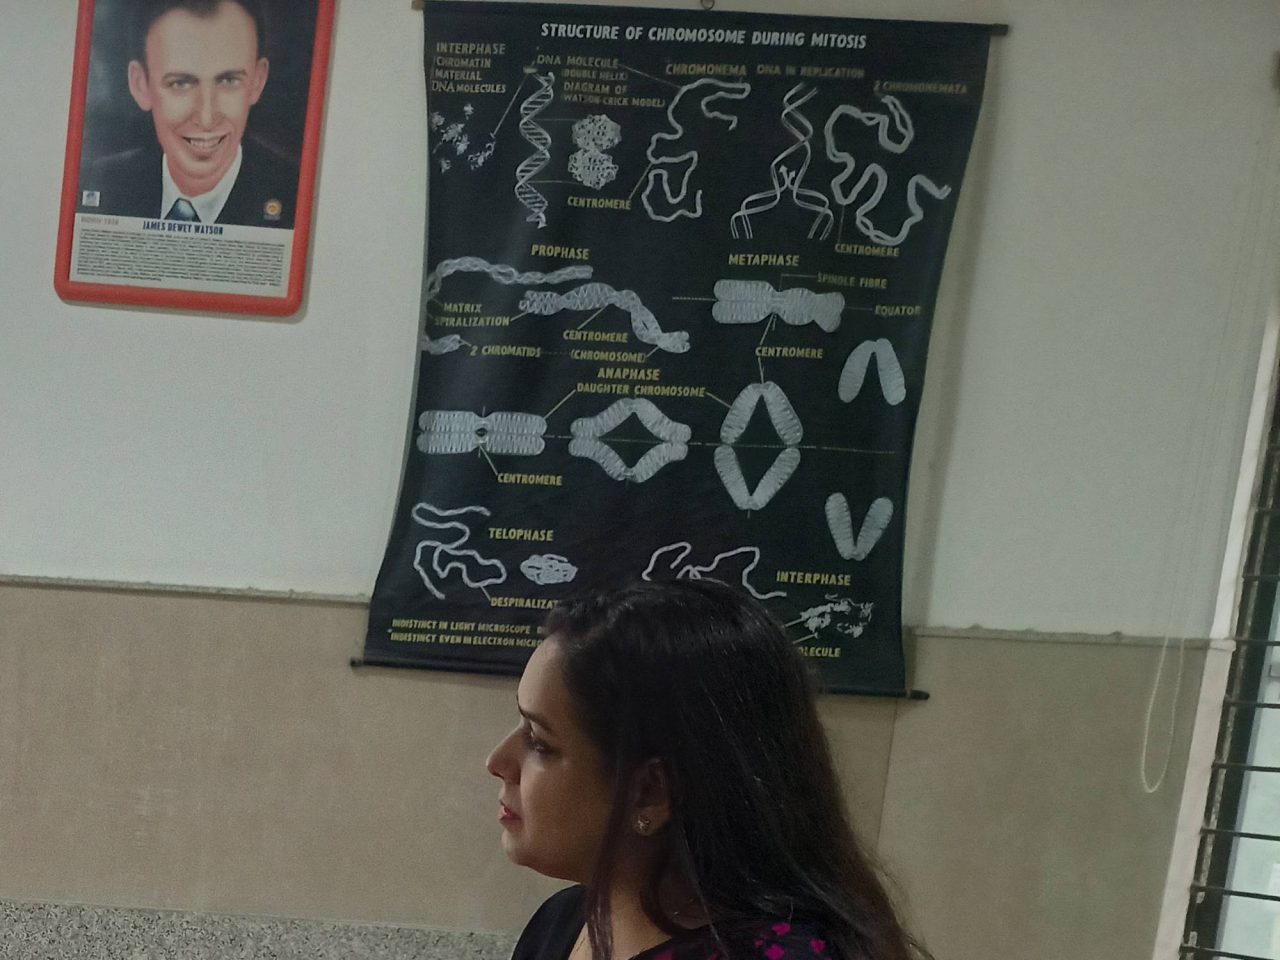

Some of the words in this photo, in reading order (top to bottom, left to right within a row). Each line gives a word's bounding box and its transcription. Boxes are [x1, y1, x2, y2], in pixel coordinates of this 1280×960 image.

[541, 23, 619, 40] STRUCTURE
[625, 26, 643, 40] OF
[648, 27, 746, 44] CHROMOSOME
[752, 31, 805, 47] DURING
[811, 33, 867, 49] MITOSIS
[436, 42, 506, 55] INTERPHASE
[537, 54, 561, 65] DNA
[566, 55, 619, 69] MOLECULE
[434, 69, 483, 81] MATERIAL
[665, 64, 746, 77] CHROMONEMA
[756, 65, 781, 75] DNA
[800, 66, 865, 79] REPLICATION
[431, 81, 455, 93] DNA
[456, 83, 507, 94] MOLECULES
[563, 82, 612, 94] DIAGRAM
[614, 84, 628, 94] OF
[567, 196, 632, 210] CENTROMERE
[143, 220, 166, 232] JAMES
[167, 222, 192, 233] DEWEY
[194, 224, 224, 236] WATSON
[531, 244, 590, 260] PROPHASE
[834, 243, 900, 257] CENTROMERE
[728, 254, 800, 267] METAPHASE
[817, 272, 855, 287] SPINDLE
[859, 277, 888, 289] FIBRE
[443, 302, 482, 313] MATRIX
[874, 305, 921, 316] EQUATOR
[435, 315, 510, 327] SPIRALIZATION
[563, 329, 629, 343] CENTROMERE
[470, 346, 478, 357] 2
[481, 346, 541, 358] CHROMATIDS
[570, 349, 647, 364] (CHROMOSOME)
[755, 346, 824, 359] CENTROMERE
[597, 367, 661, 381] ANAPHASE
[576, 382, 631, 395] DAUGHTER
[634, 384, 706, 398] CHROMOSOME
[497, 473, 563, 486] CENTROMERE
[489, 527, 555, 542] TELOPHASE
[776, 571, 852, 586] INTERPHASE
[490, 597, 559, 610] DESPIRALIZAT
[392, 618, 438, 630] INDISTINCT
[438, 620, 449, 631] IN
[450, 621, 476, 632] LIGHT
[477, 623, 531, 635] MICROSCOPE
[390, 632, 437, 643] INDISTINCT
[439, 634, 462, 645] EVEN
[463, 635, 472, 645] IN
[472, 636, 515, 647] ELECTRON
[516, 638, 545, 648] MICRO
